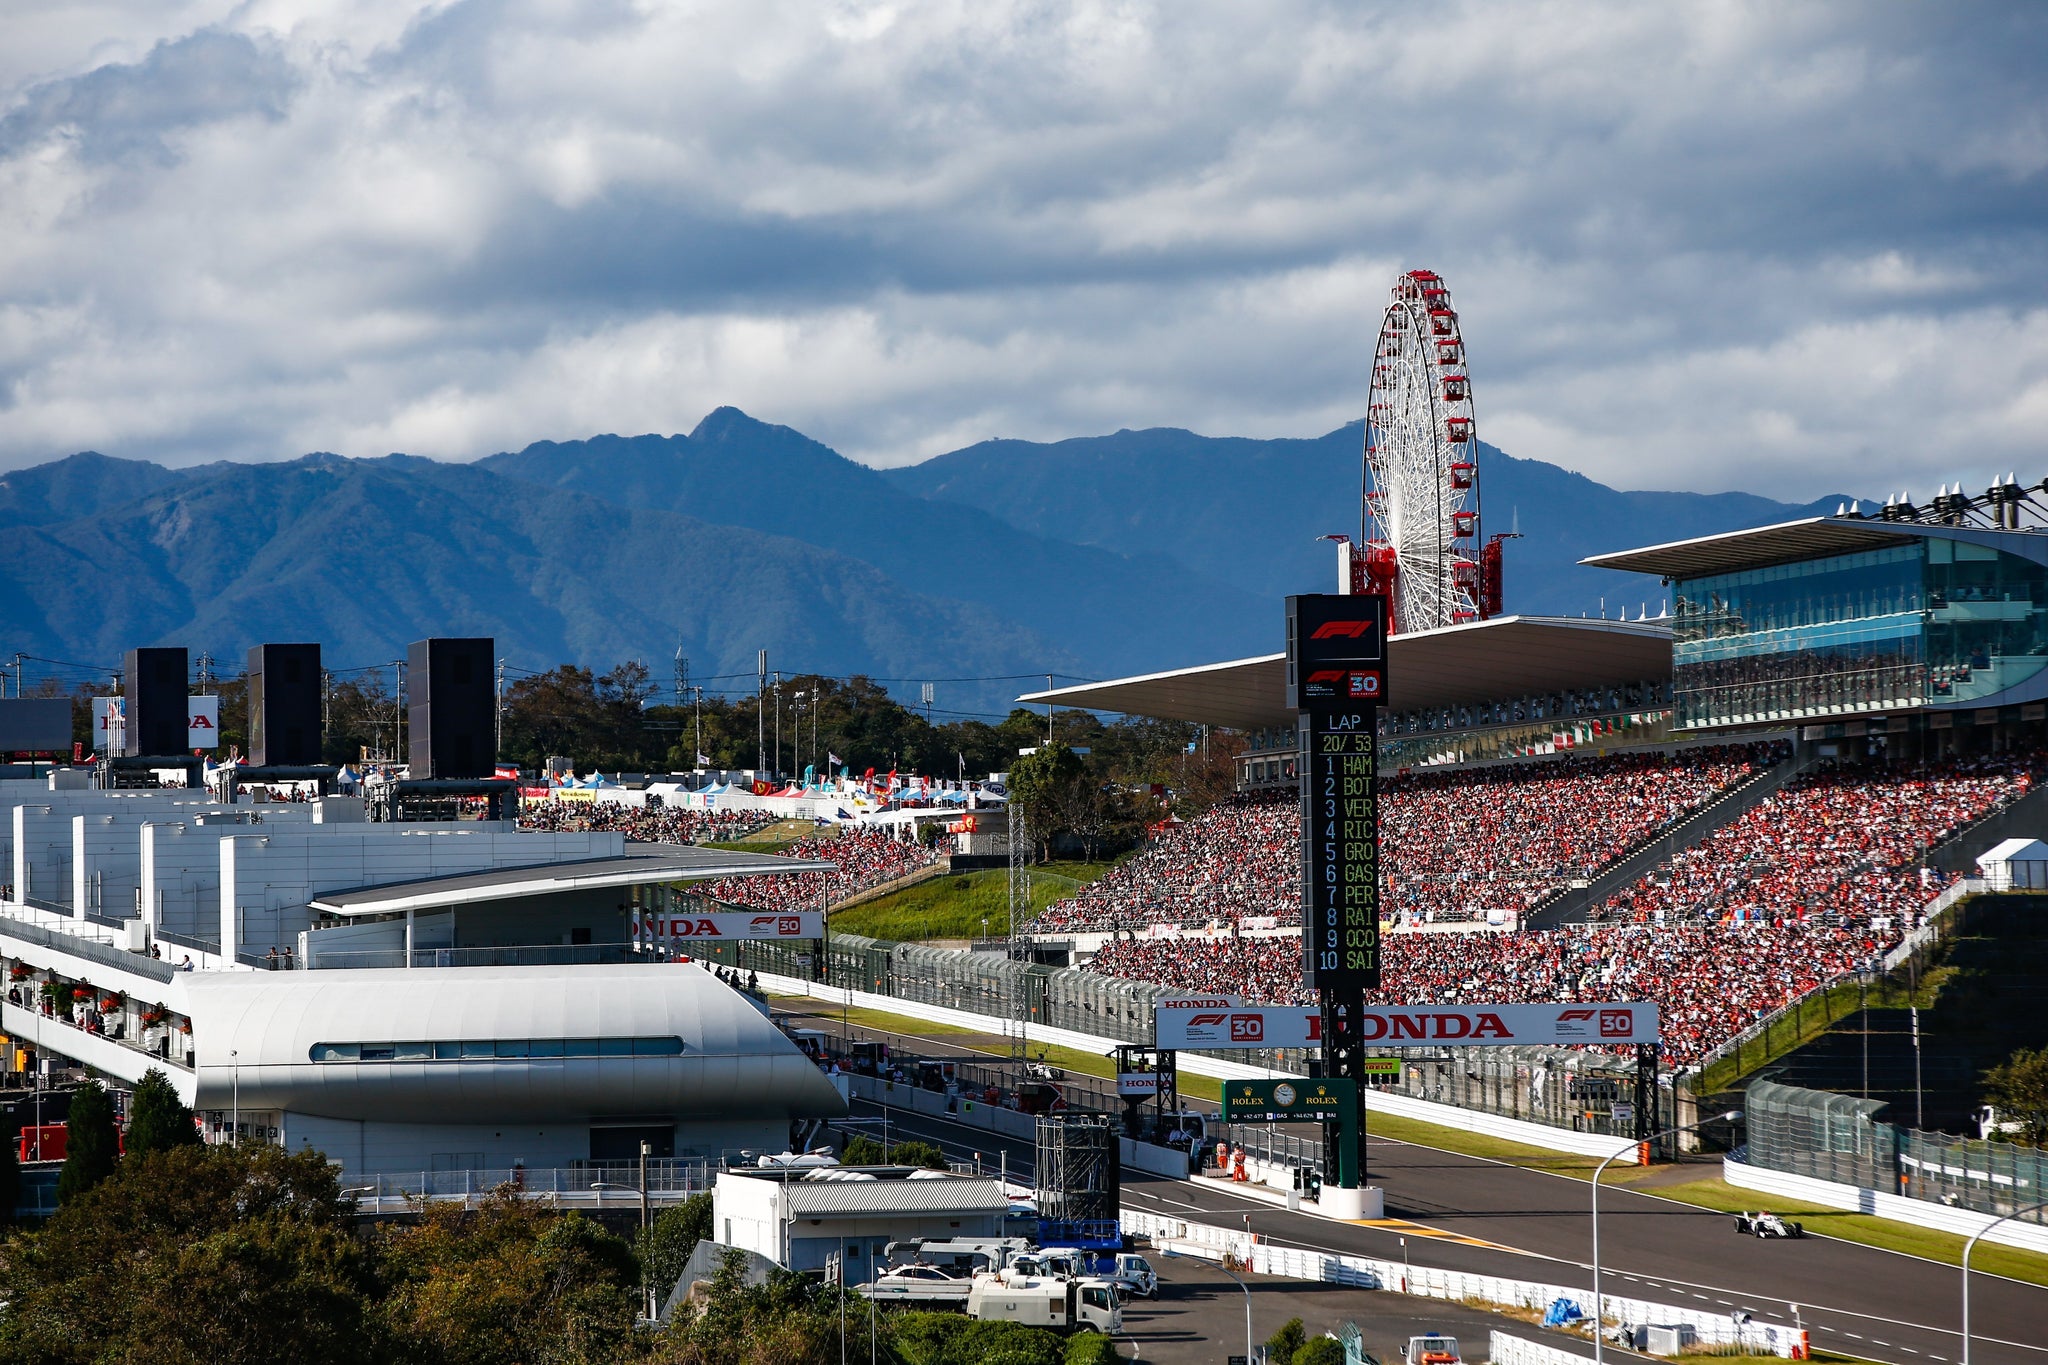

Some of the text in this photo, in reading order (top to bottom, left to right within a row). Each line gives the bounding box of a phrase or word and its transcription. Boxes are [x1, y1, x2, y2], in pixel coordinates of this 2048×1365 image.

[1350, 676, 1378, 692] 30
[1329, 714, 1361, 730] LAP
[1323, 735, 1372, 752] 20/ 53
[1327, 756, 1372, 775] 1 HAM
[1325, 777, 1372, 796] 2 BOT
[1325, 799, 1373, 818] 3 VER
[1326, 820, 1373, 839] 4 RIC
[1326, 842, 1373, 861] 5 GRO
[1326, 864, 1374, 882] 6 GAS
[1326, 886, 1374, 904] 7 PER
[780, 920, 799, 931] 30
[1327, 907, 1373, 926] 8 RAI
[1327, 929, 1375, 948] 9 OCO
[1320, 951, 1374, 970] 10 SAI
[1164, 999, 1231, 1008] HONDA
[1232, 1019, 1261, 1036] 30
[1602, 1015, 1631, 1032] 30
